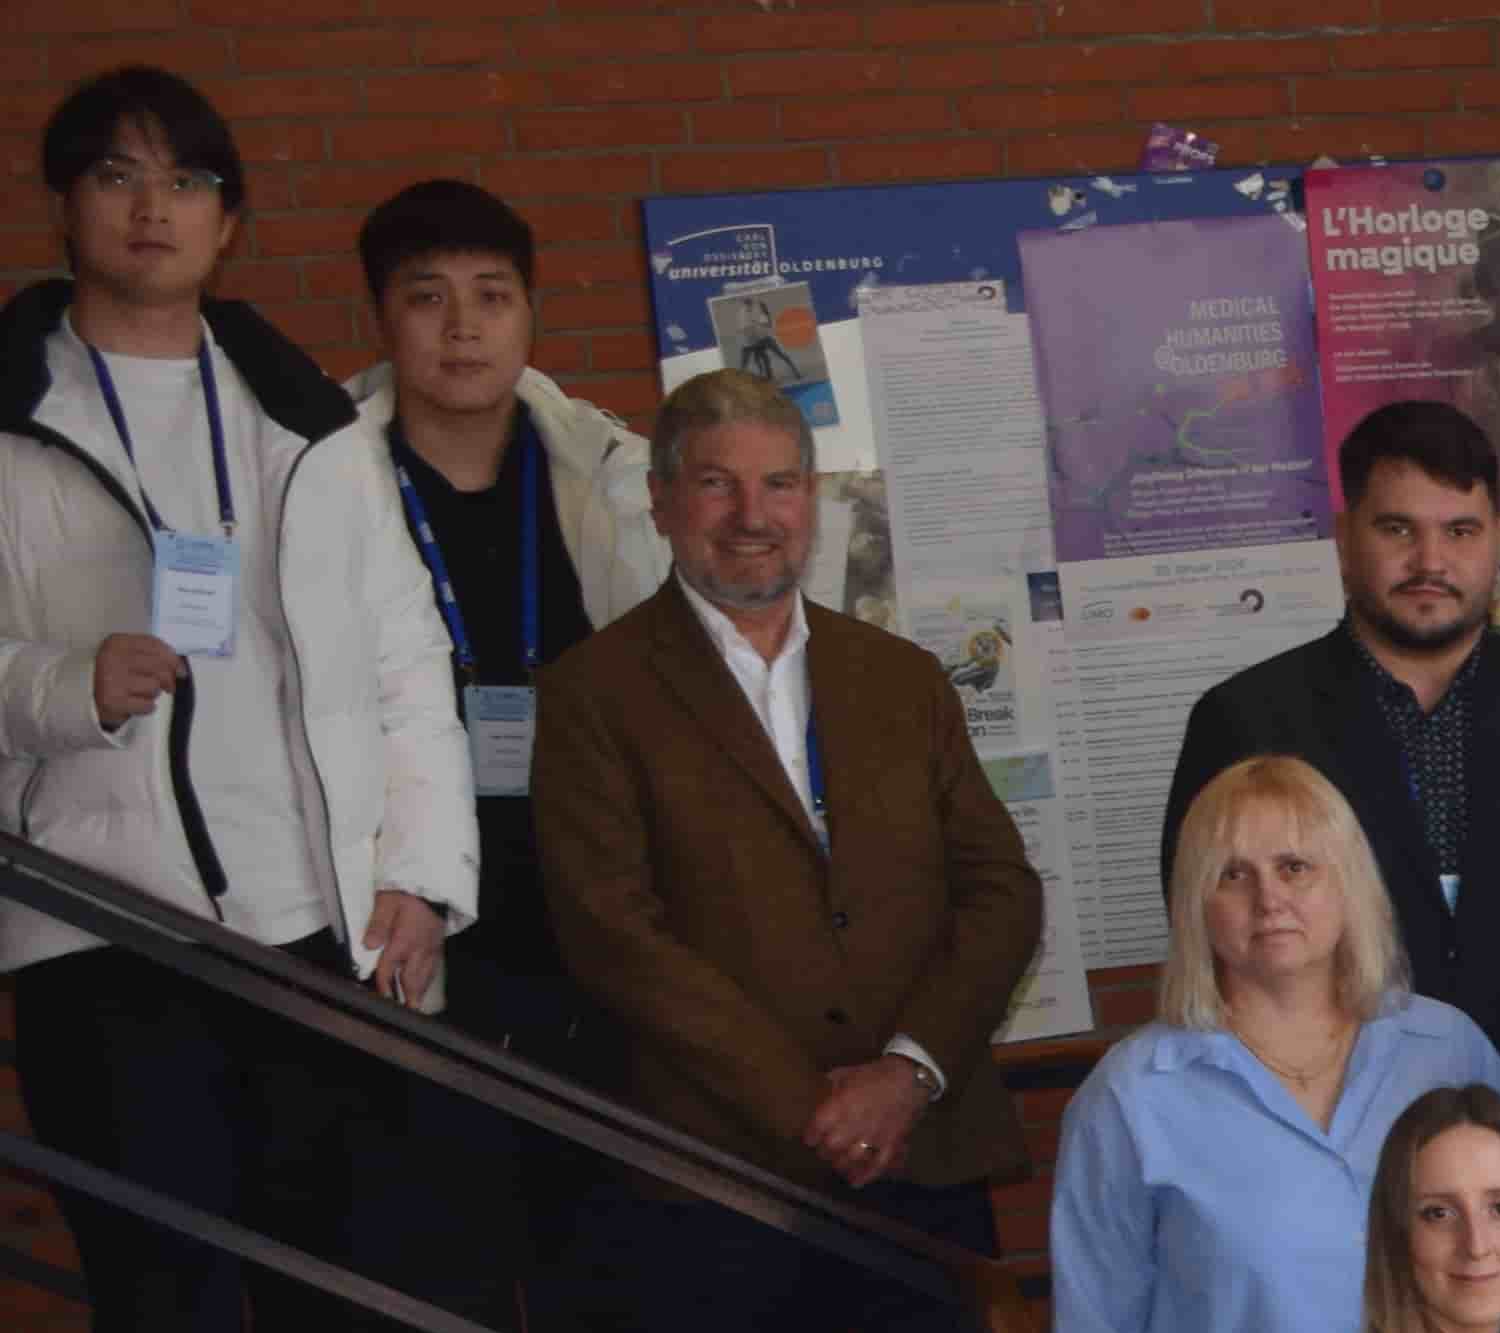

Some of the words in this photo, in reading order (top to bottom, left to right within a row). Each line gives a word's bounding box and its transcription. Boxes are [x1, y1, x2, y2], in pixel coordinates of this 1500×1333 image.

[1322, 199, 1489, 240] L'Horloge
[668, 262, 770, 281] universität
[779, 256, 886, 274] OLDENBURG
[1326, 234, 1480, 277] magique
[1188, 295, 1281, 321] MEDICAL
[1166, 319, 1282, 346] HUMANITIES
